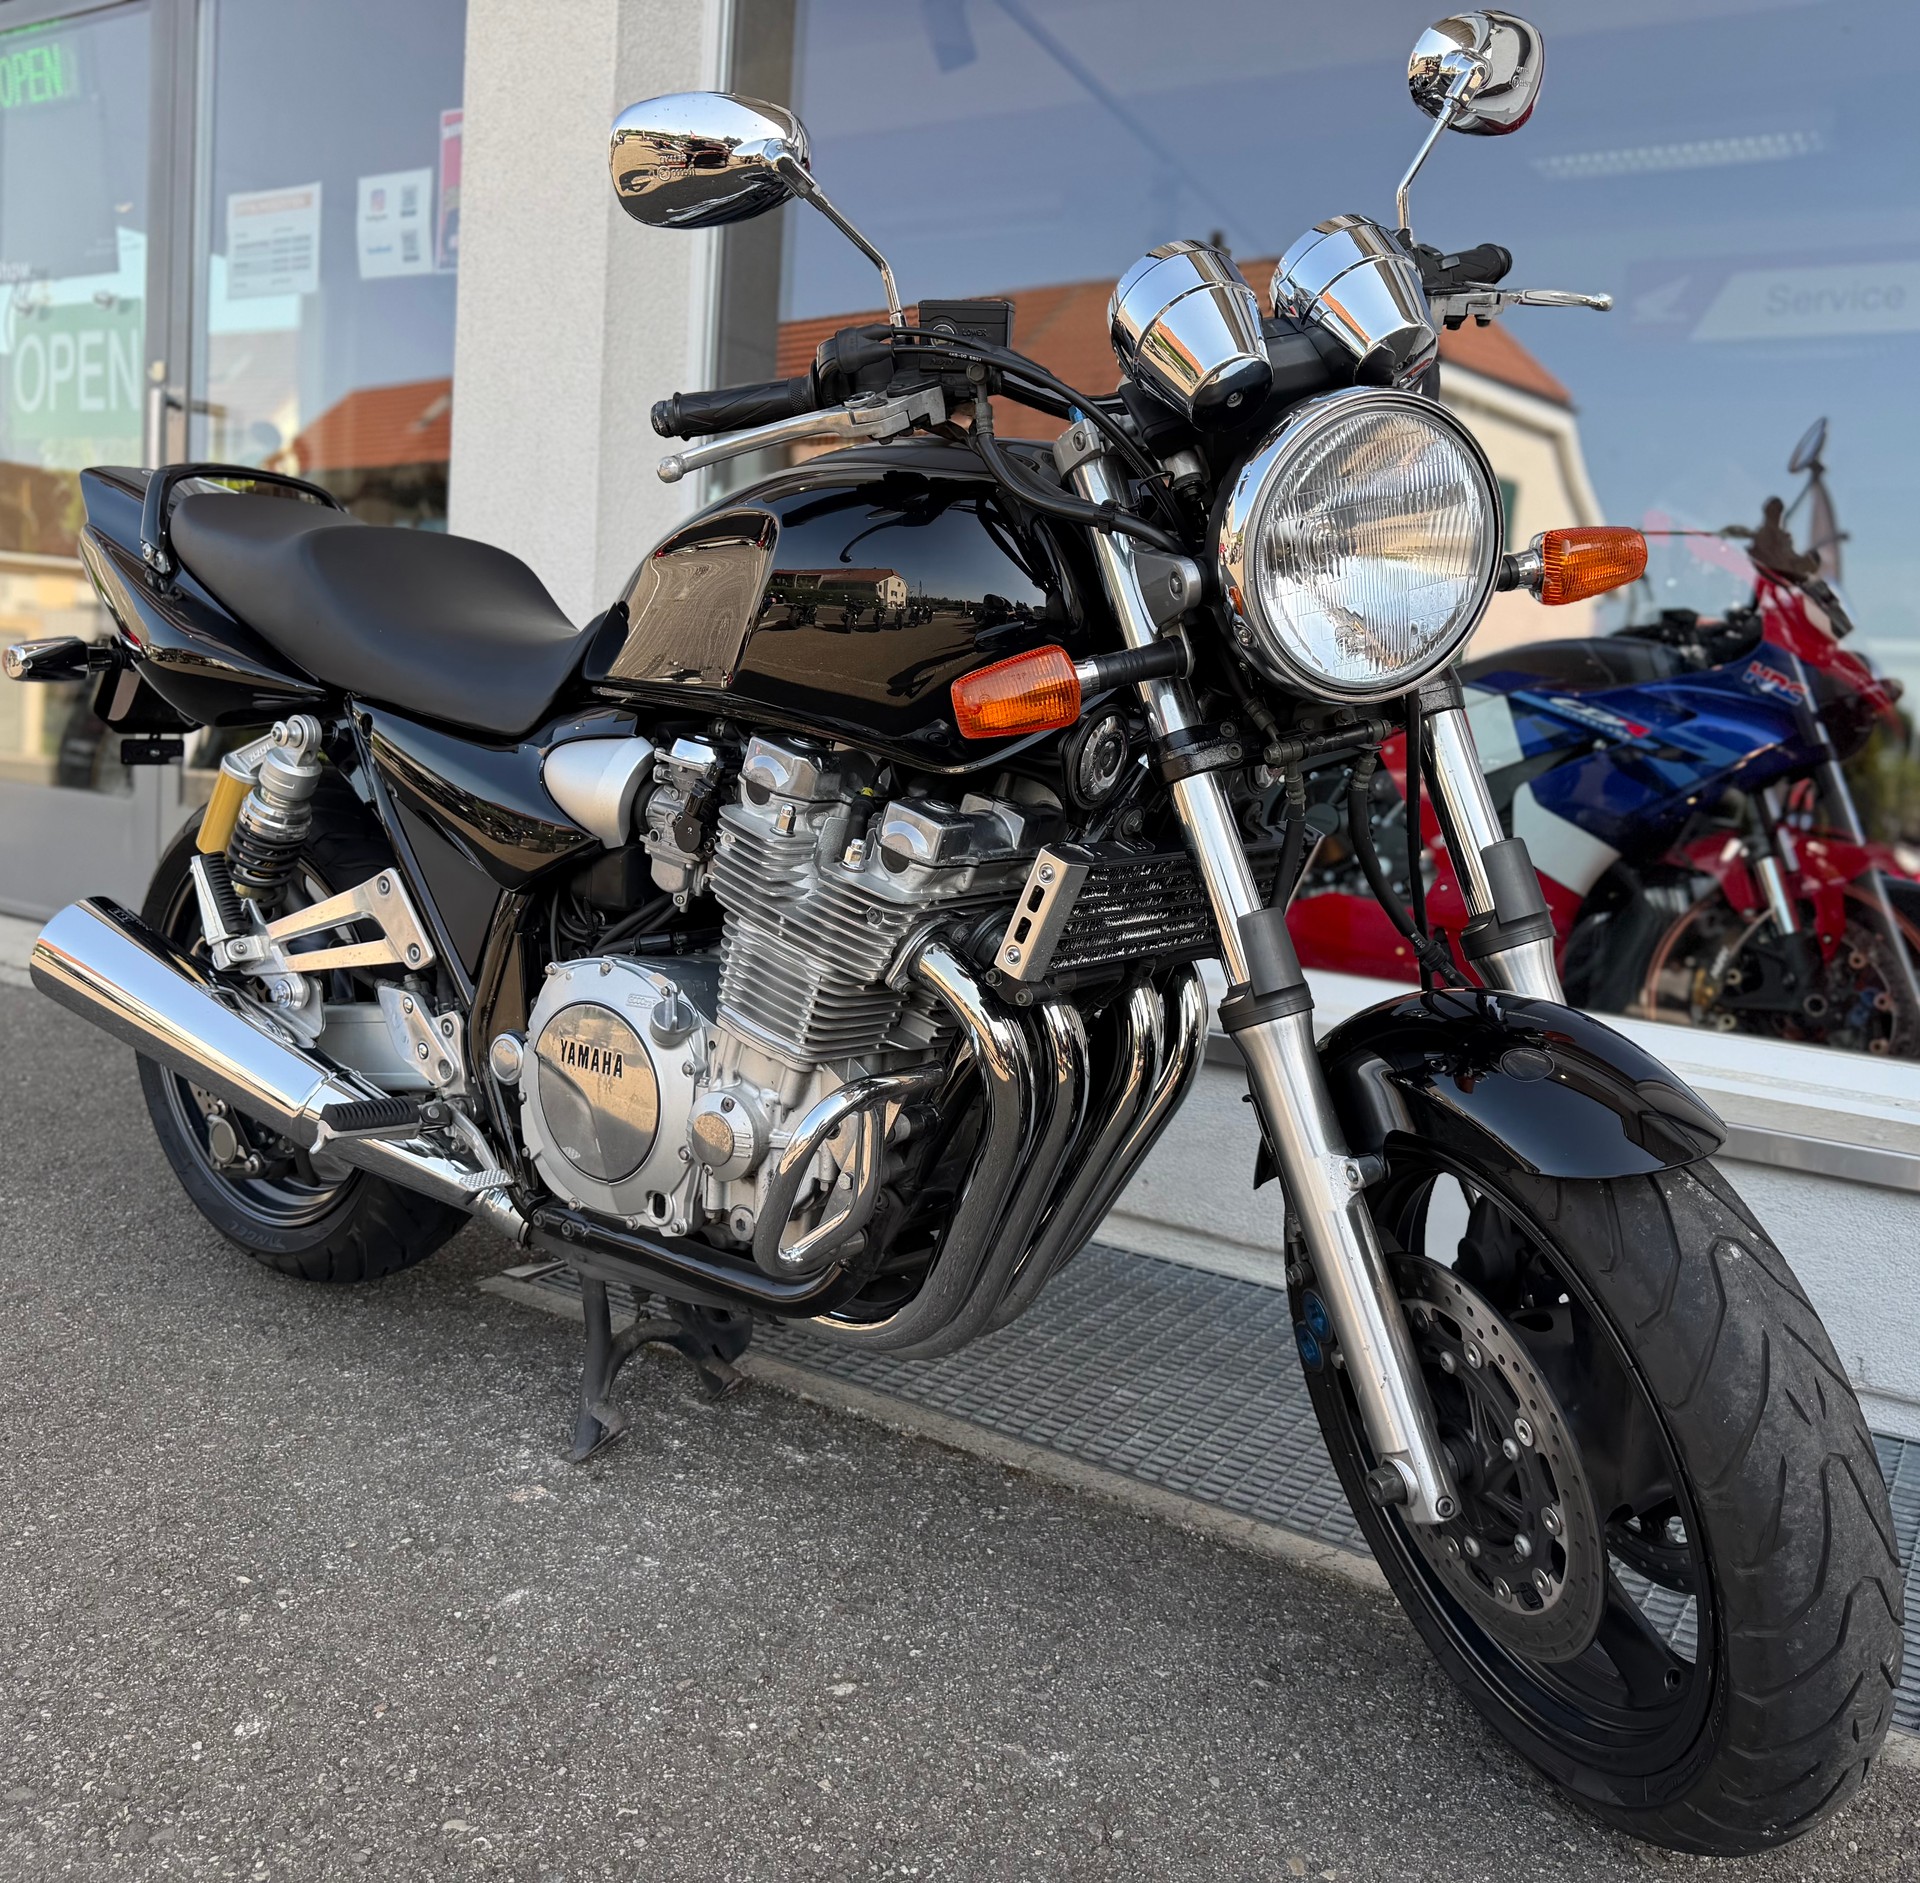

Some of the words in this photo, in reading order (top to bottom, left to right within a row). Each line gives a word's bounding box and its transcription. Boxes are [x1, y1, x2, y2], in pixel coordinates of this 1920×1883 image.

[0, 43, 63, 107] OPEN
[1764, 280, 1907, 317] Service
[14, 328, 141, 413] OPEN
[560, 1038, 623, 1079] YAMAHA
